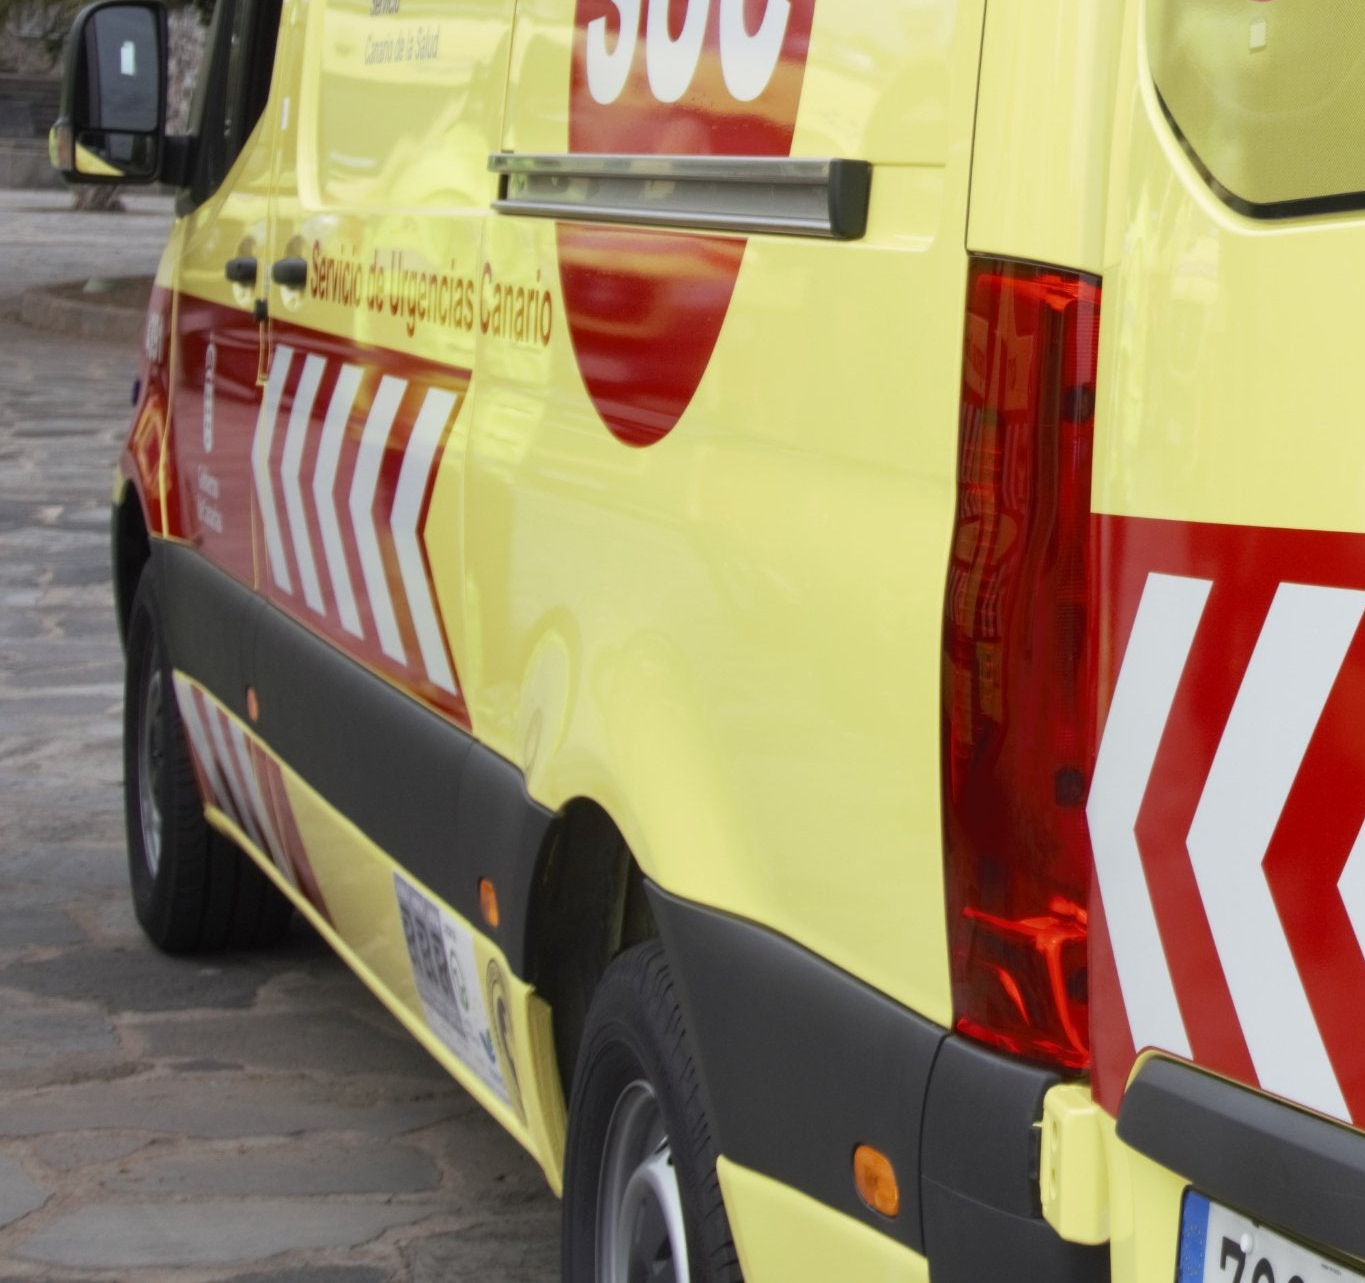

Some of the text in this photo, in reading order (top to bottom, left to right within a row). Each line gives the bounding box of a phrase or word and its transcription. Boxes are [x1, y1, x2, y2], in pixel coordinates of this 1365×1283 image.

[310, 240, 553, 347] Servicio de Urgencias Canario
